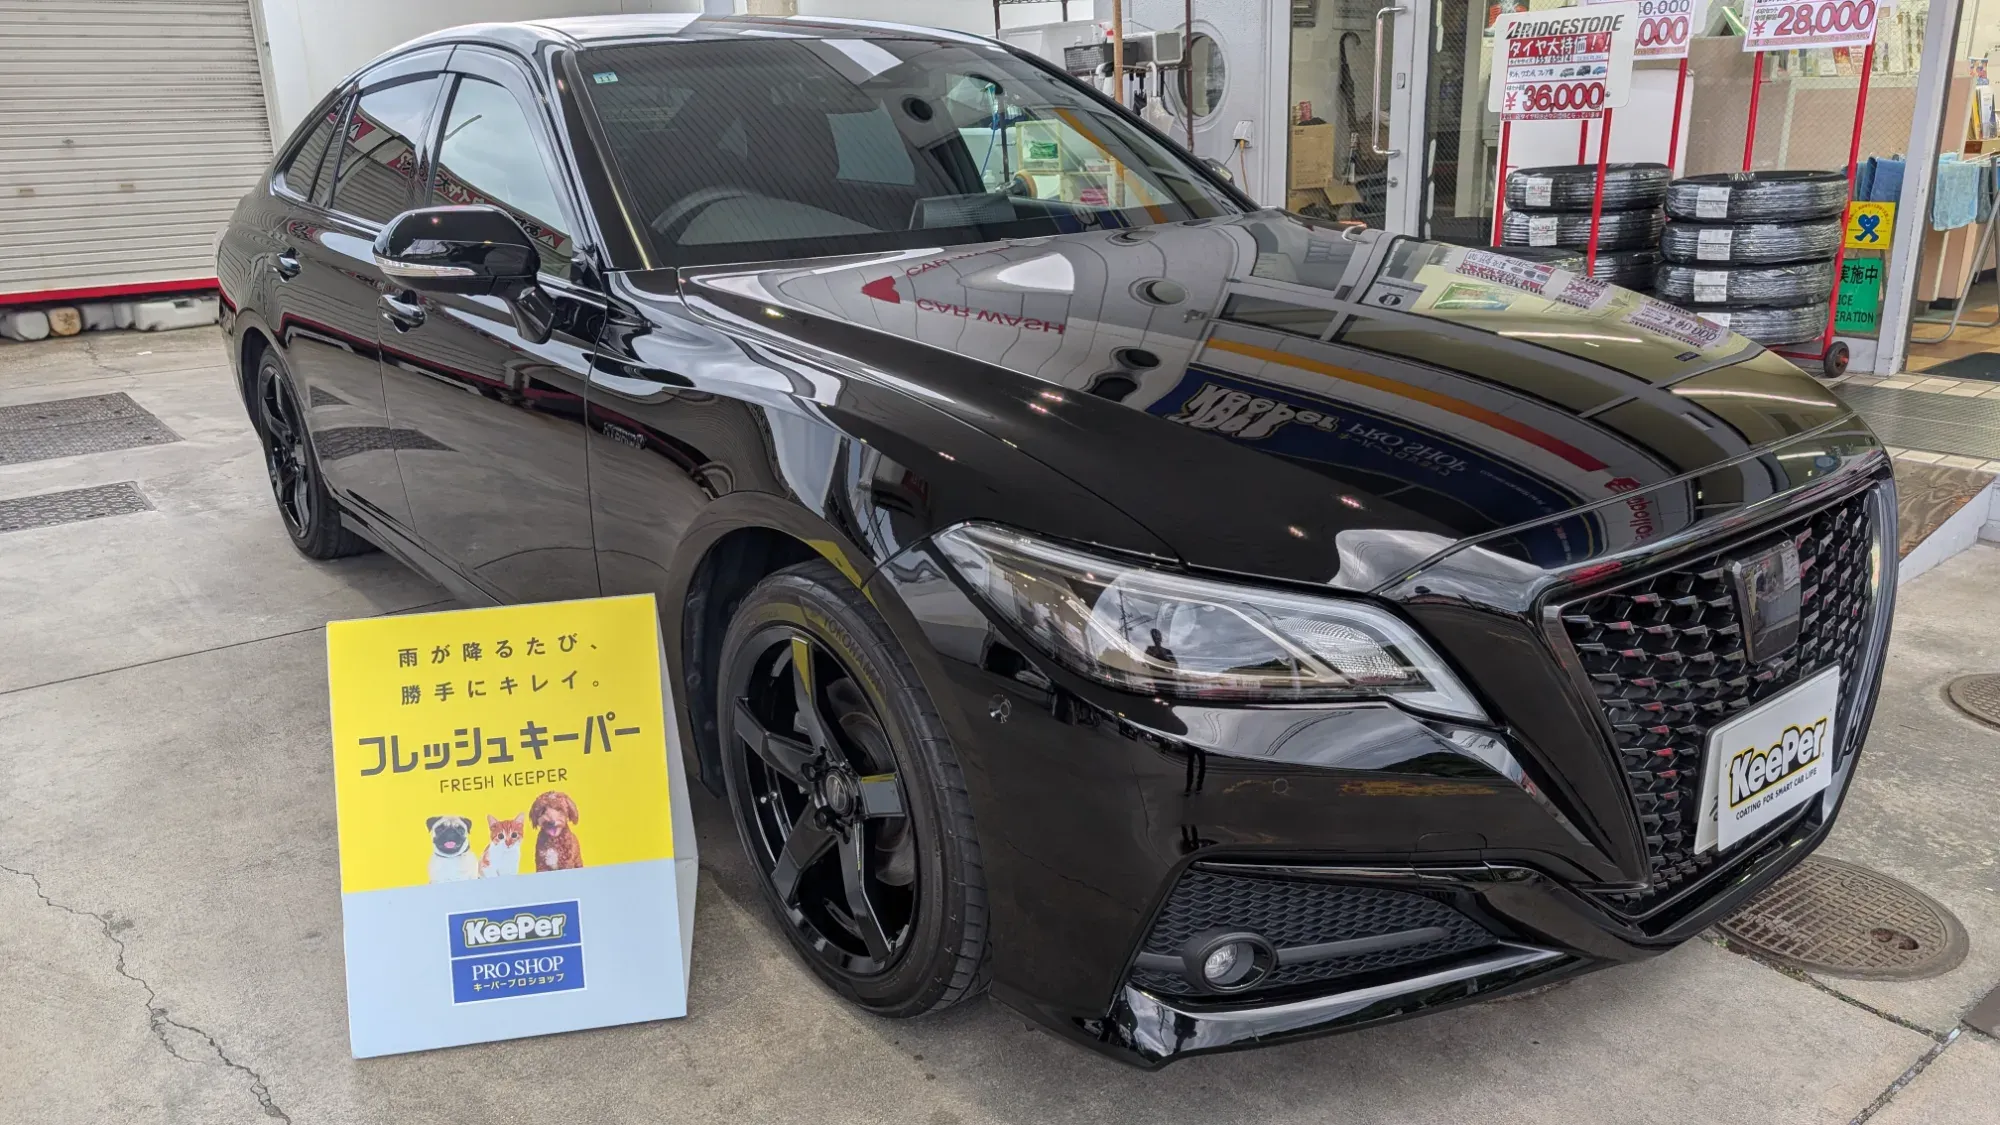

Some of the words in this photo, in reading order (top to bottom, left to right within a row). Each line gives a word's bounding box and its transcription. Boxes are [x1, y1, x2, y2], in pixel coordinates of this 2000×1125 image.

[1506, 14, 1625, 40] BRIDGESTONE
[1634, 16, 1689, 50] ,000
[1774, 0, 1876, 36] 28,000
[1505, 91, 1518, 110] ¥
[1522, 82, 1605, 112] 36,000
[1836, 294, 1853, 306] ICE
[1835, 311, 1874, 324] ERATION
[398, 633, 598, 668] 雨が降るたび、
[401, 670, 599, 706] 勝手にキレイ。
[358, 711, 641, 777] フレッシュキーパー
[1729, 717, 1828, 809] KeePer
[440, 775, 494, 793] FRESH
[503, 768, 568, 787] KEEPER
[1736, 801, 1762, 821] COATING
[1763, 793, 1774, 807] FOR
[1775, 781, 1793, 799] SMART
[1794, 774, 1804, 788] CAR
[1805, 767, 1817, 780] LIFE
[462, 913, 567, 948] KeePer
[472, 961, 511, 981] PRO
[514, 956, 564, 976] SHOP
[473, 973, 565, 992] キーパープロショップ
